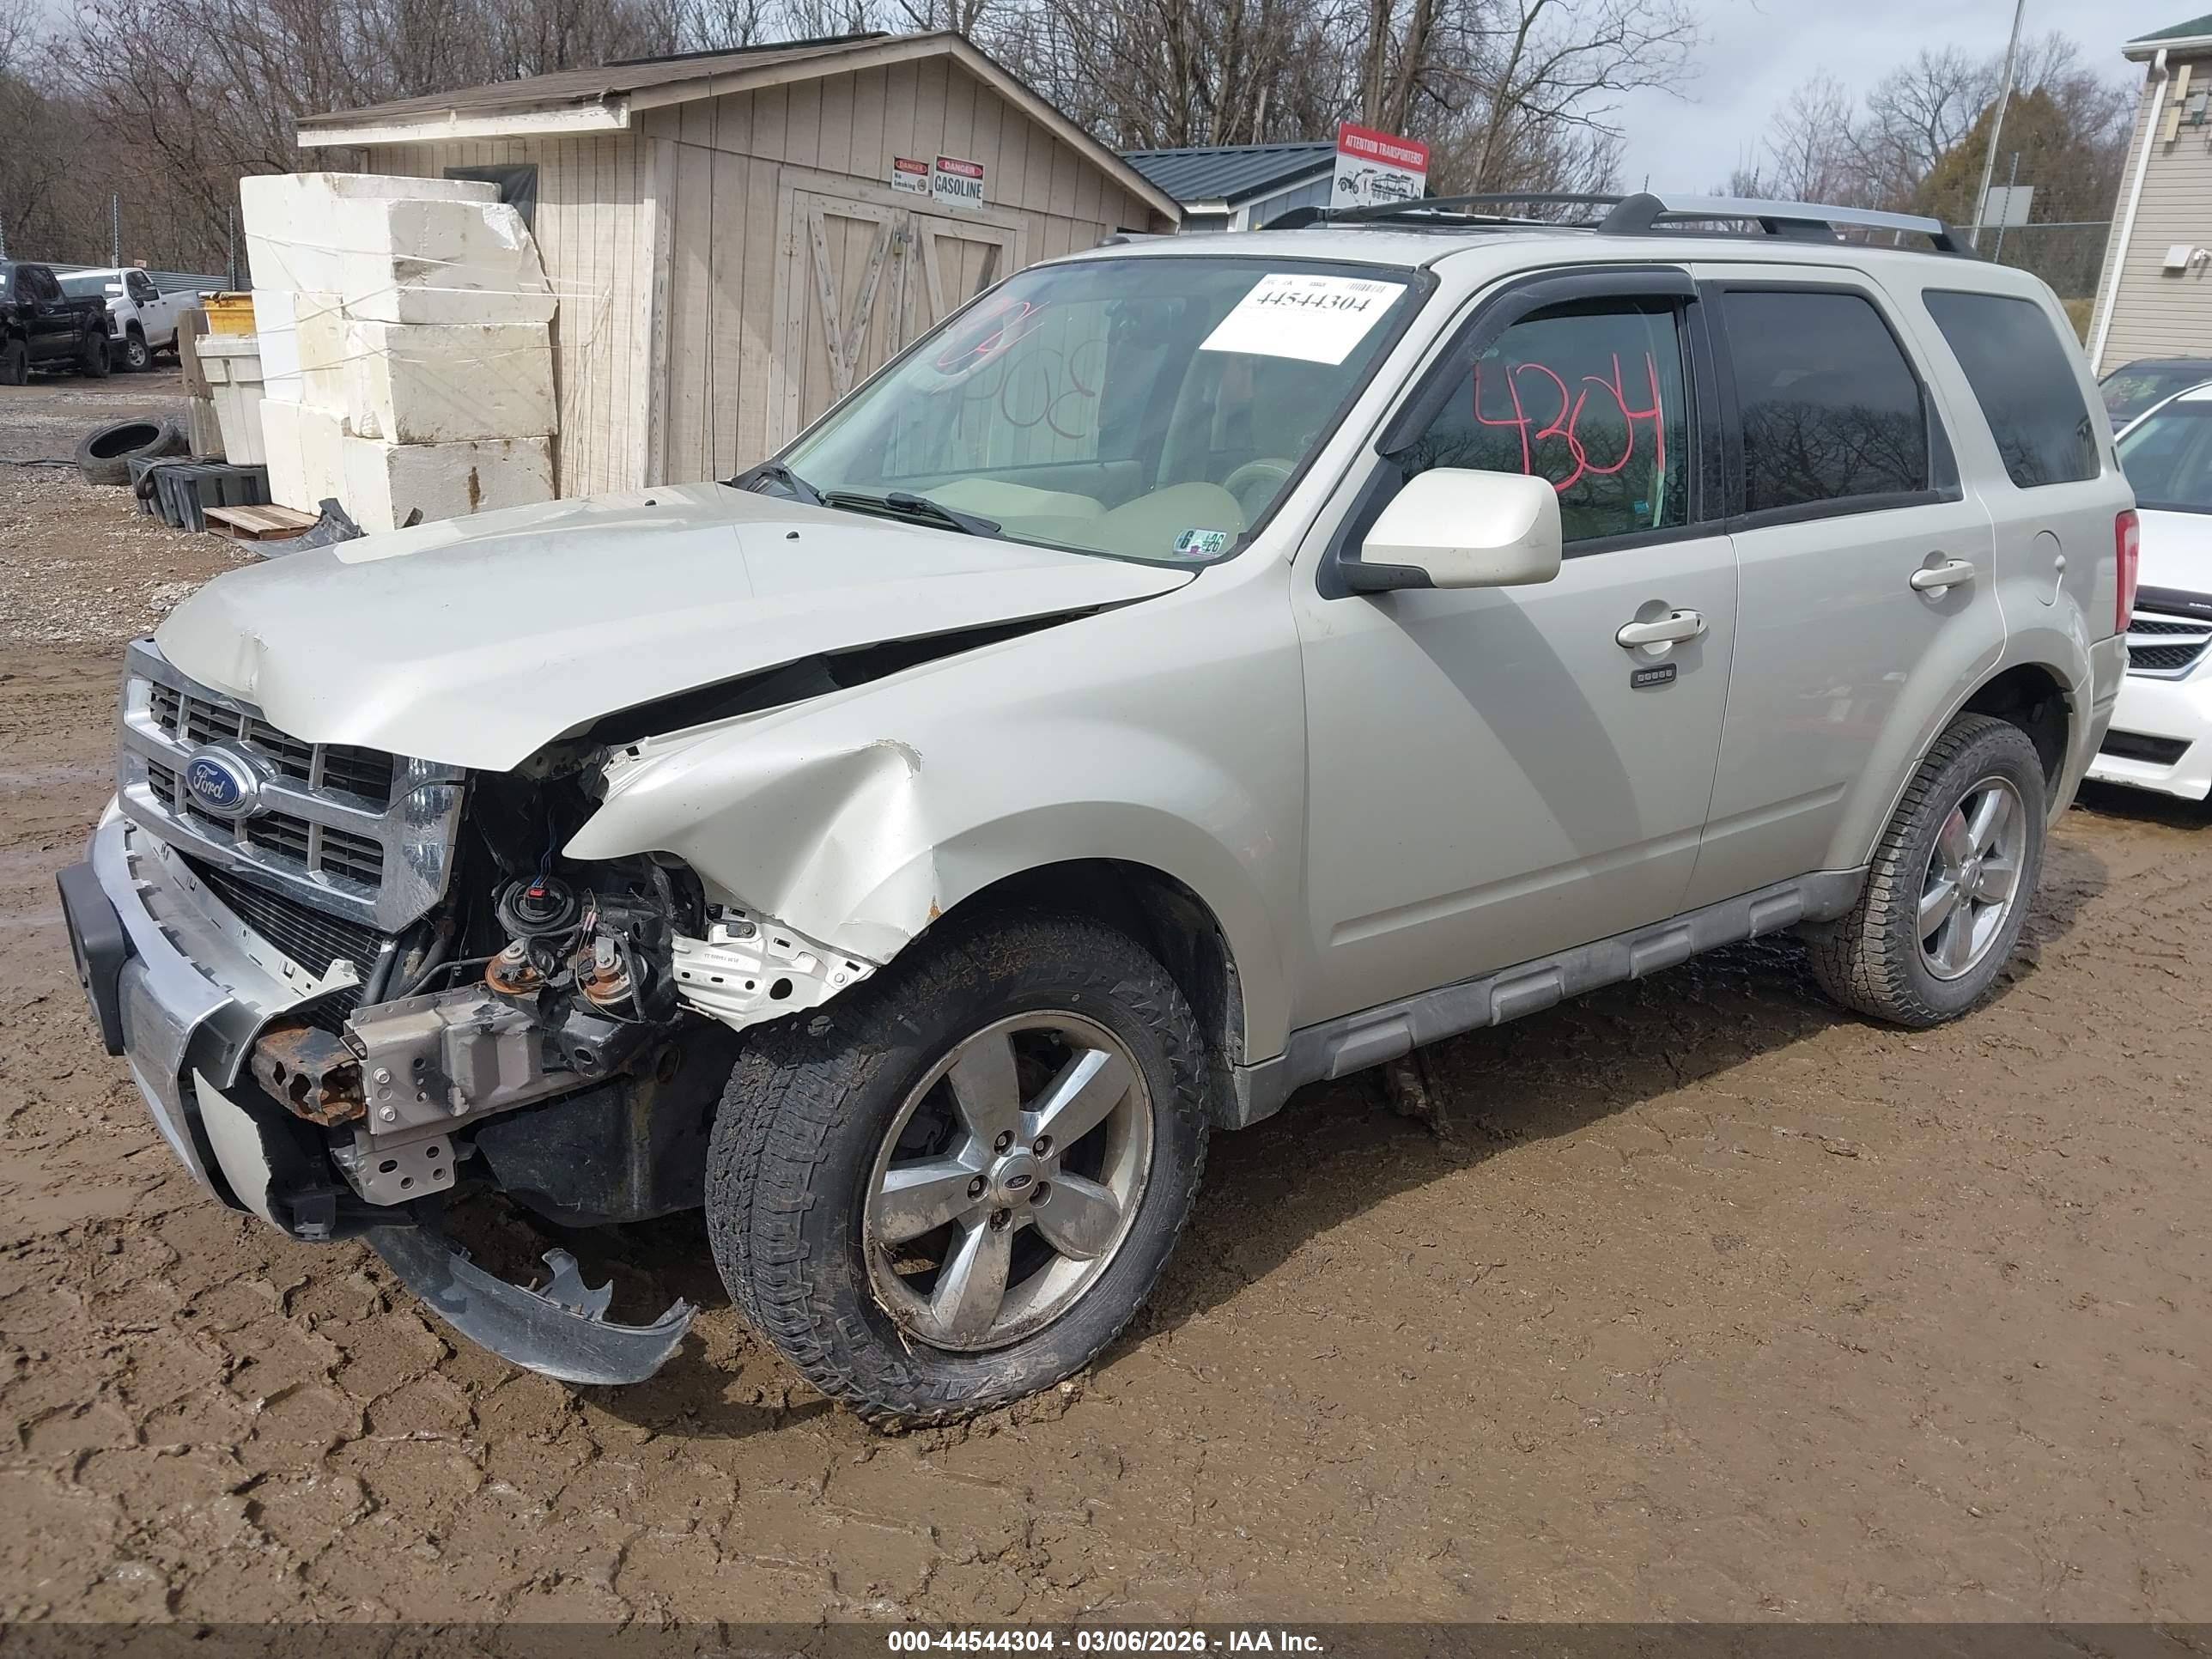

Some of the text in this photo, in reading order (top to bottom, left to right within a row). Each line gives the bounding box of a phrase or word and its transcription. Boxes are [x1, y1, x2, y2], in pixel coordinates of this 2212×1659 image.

[1345, 134, 1378, 154] ATTENTION
[945, 161, 975, 175] DANGER
[934, 175, 983, 199] GASOLINE
[1257, 291, 1371, 313] 44544304
[1474, 351, 1664, 492] 4304
[1180, 530, 1194, 550] 6
[193, 764, 225, 799] Ford
